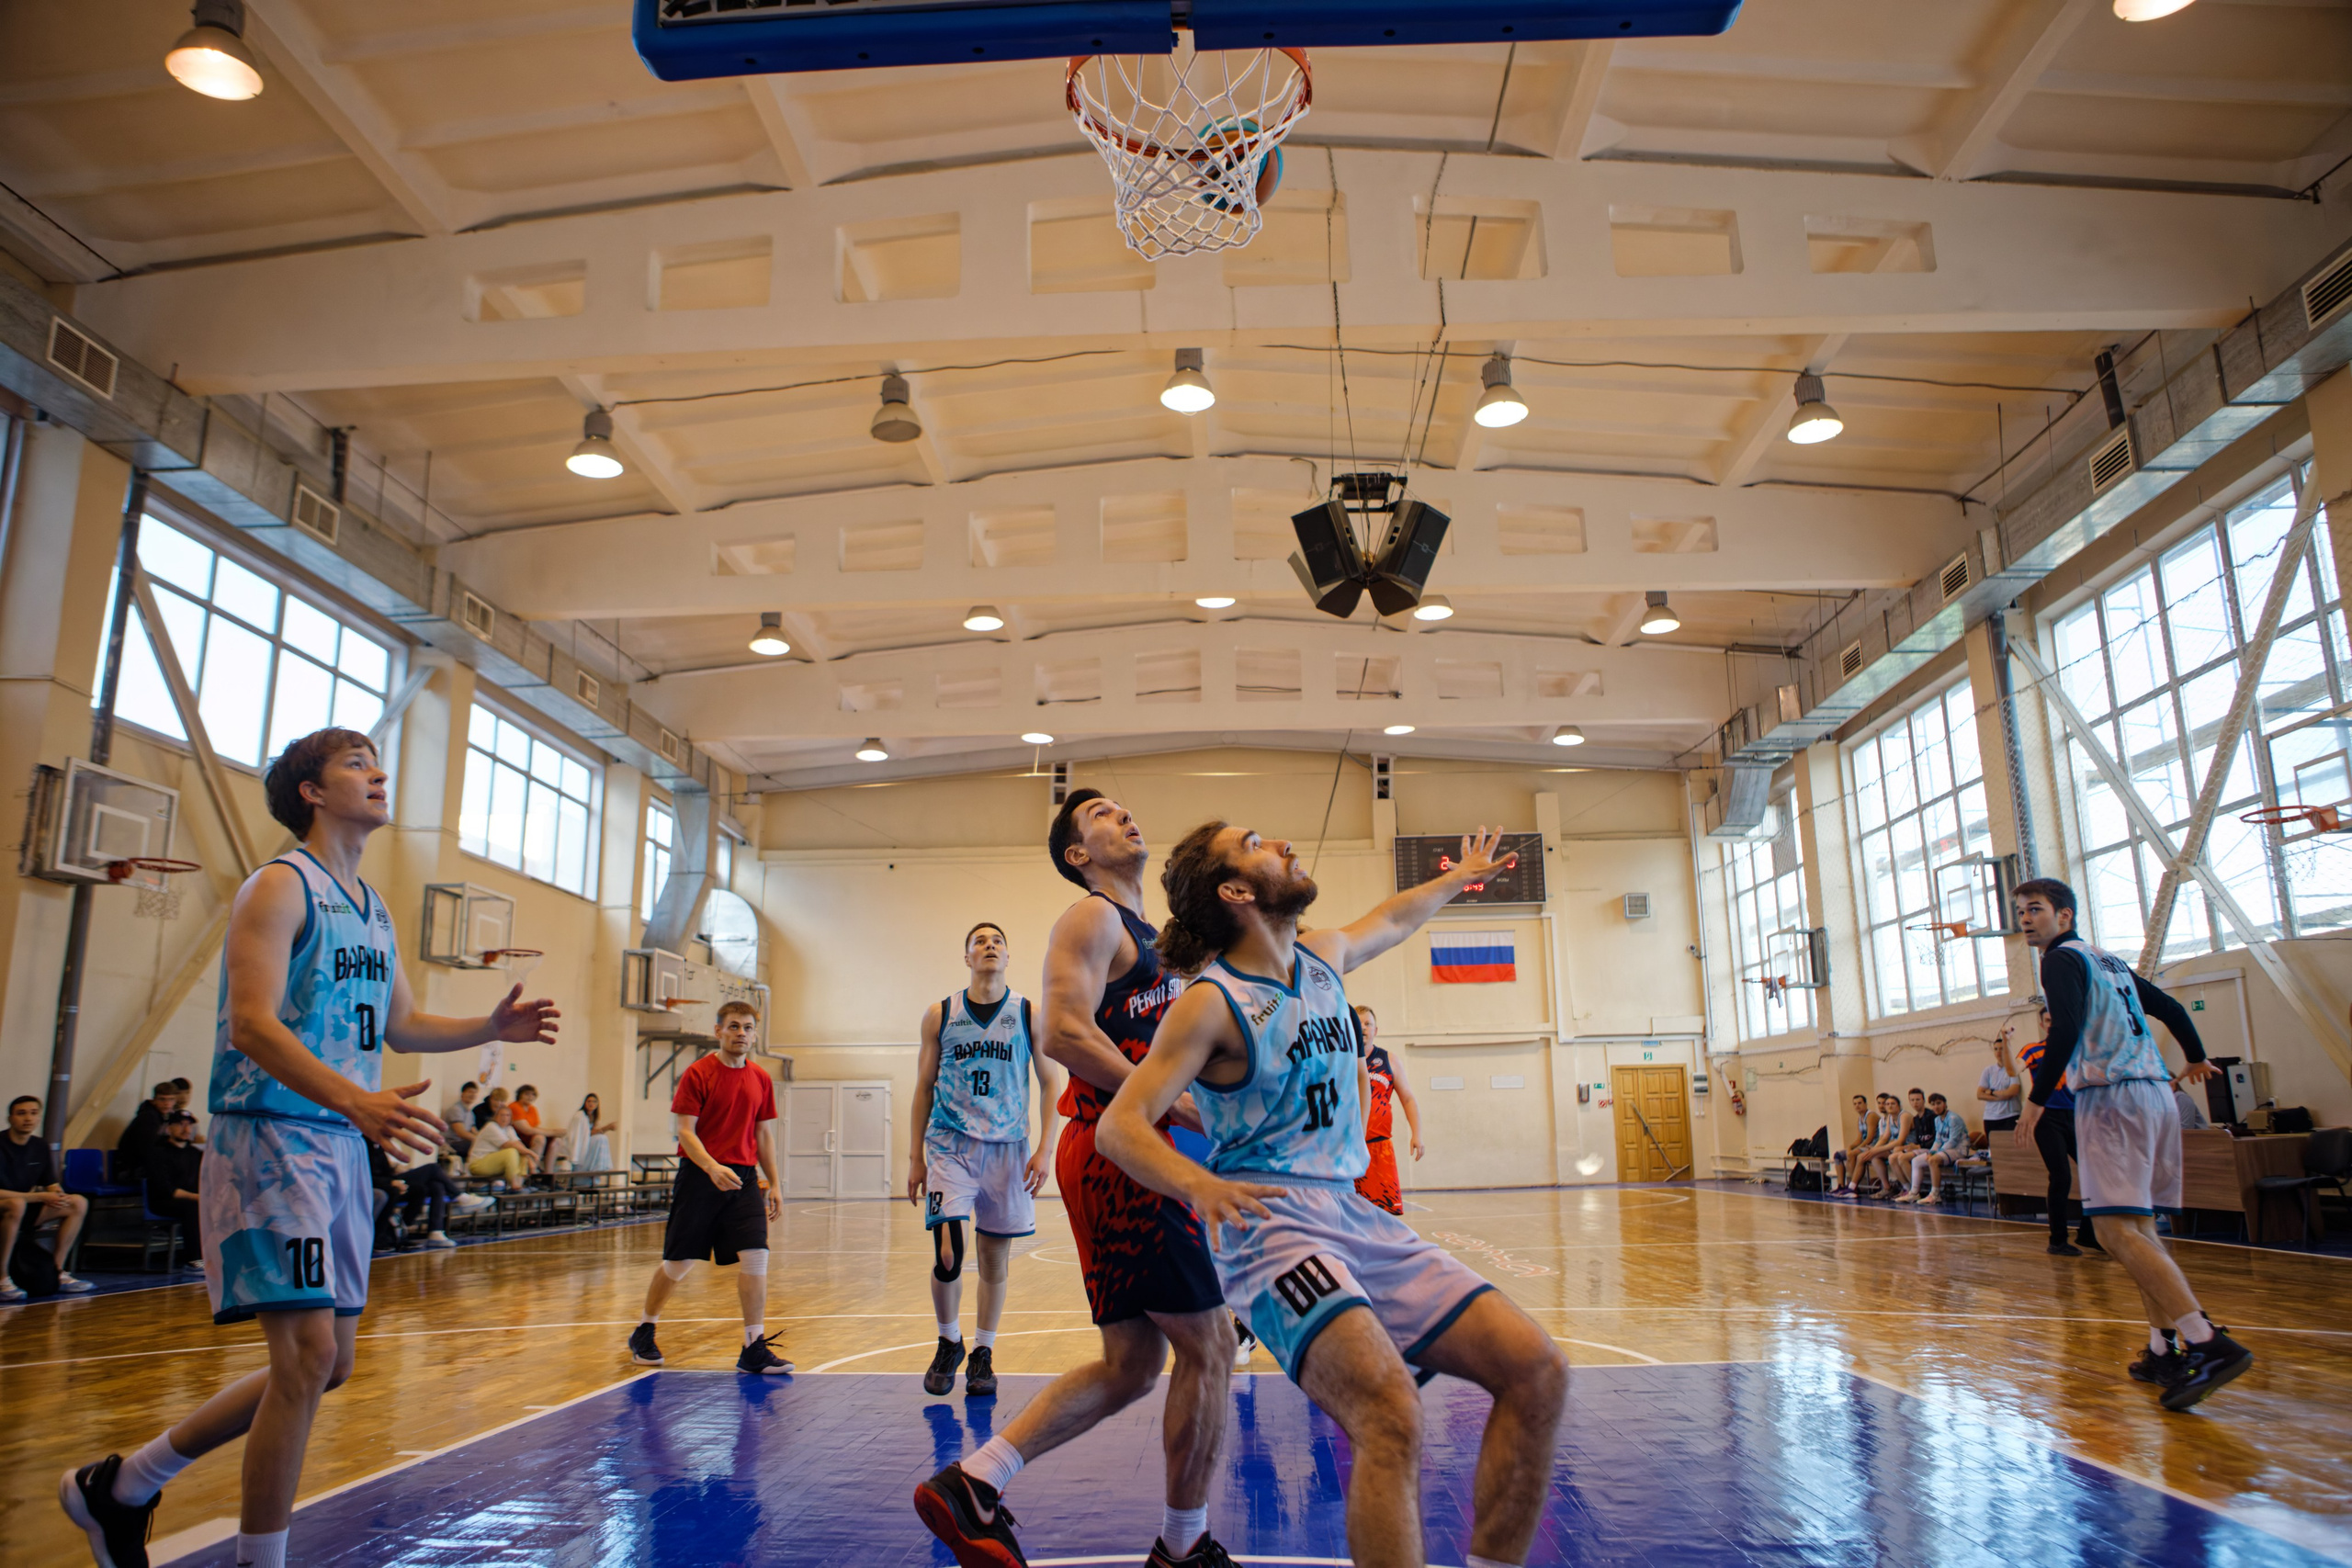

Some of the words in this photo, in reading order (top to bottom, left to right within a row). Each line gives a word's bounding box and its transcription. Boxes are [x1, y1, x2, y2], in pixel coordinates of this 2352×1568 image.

[334, 944, 389, 983] ВАРАН
[1129, 984, 1165, 1019] PERM
[955, 1040, 1013, 1062] ВАРАНЫ
[971, 1070, 990, 1096] 13
[928, 1191, 944, 1216] 13
[286, 1237, 325, 1289] 10
[1274, 1255, 1340, 1317] 00
